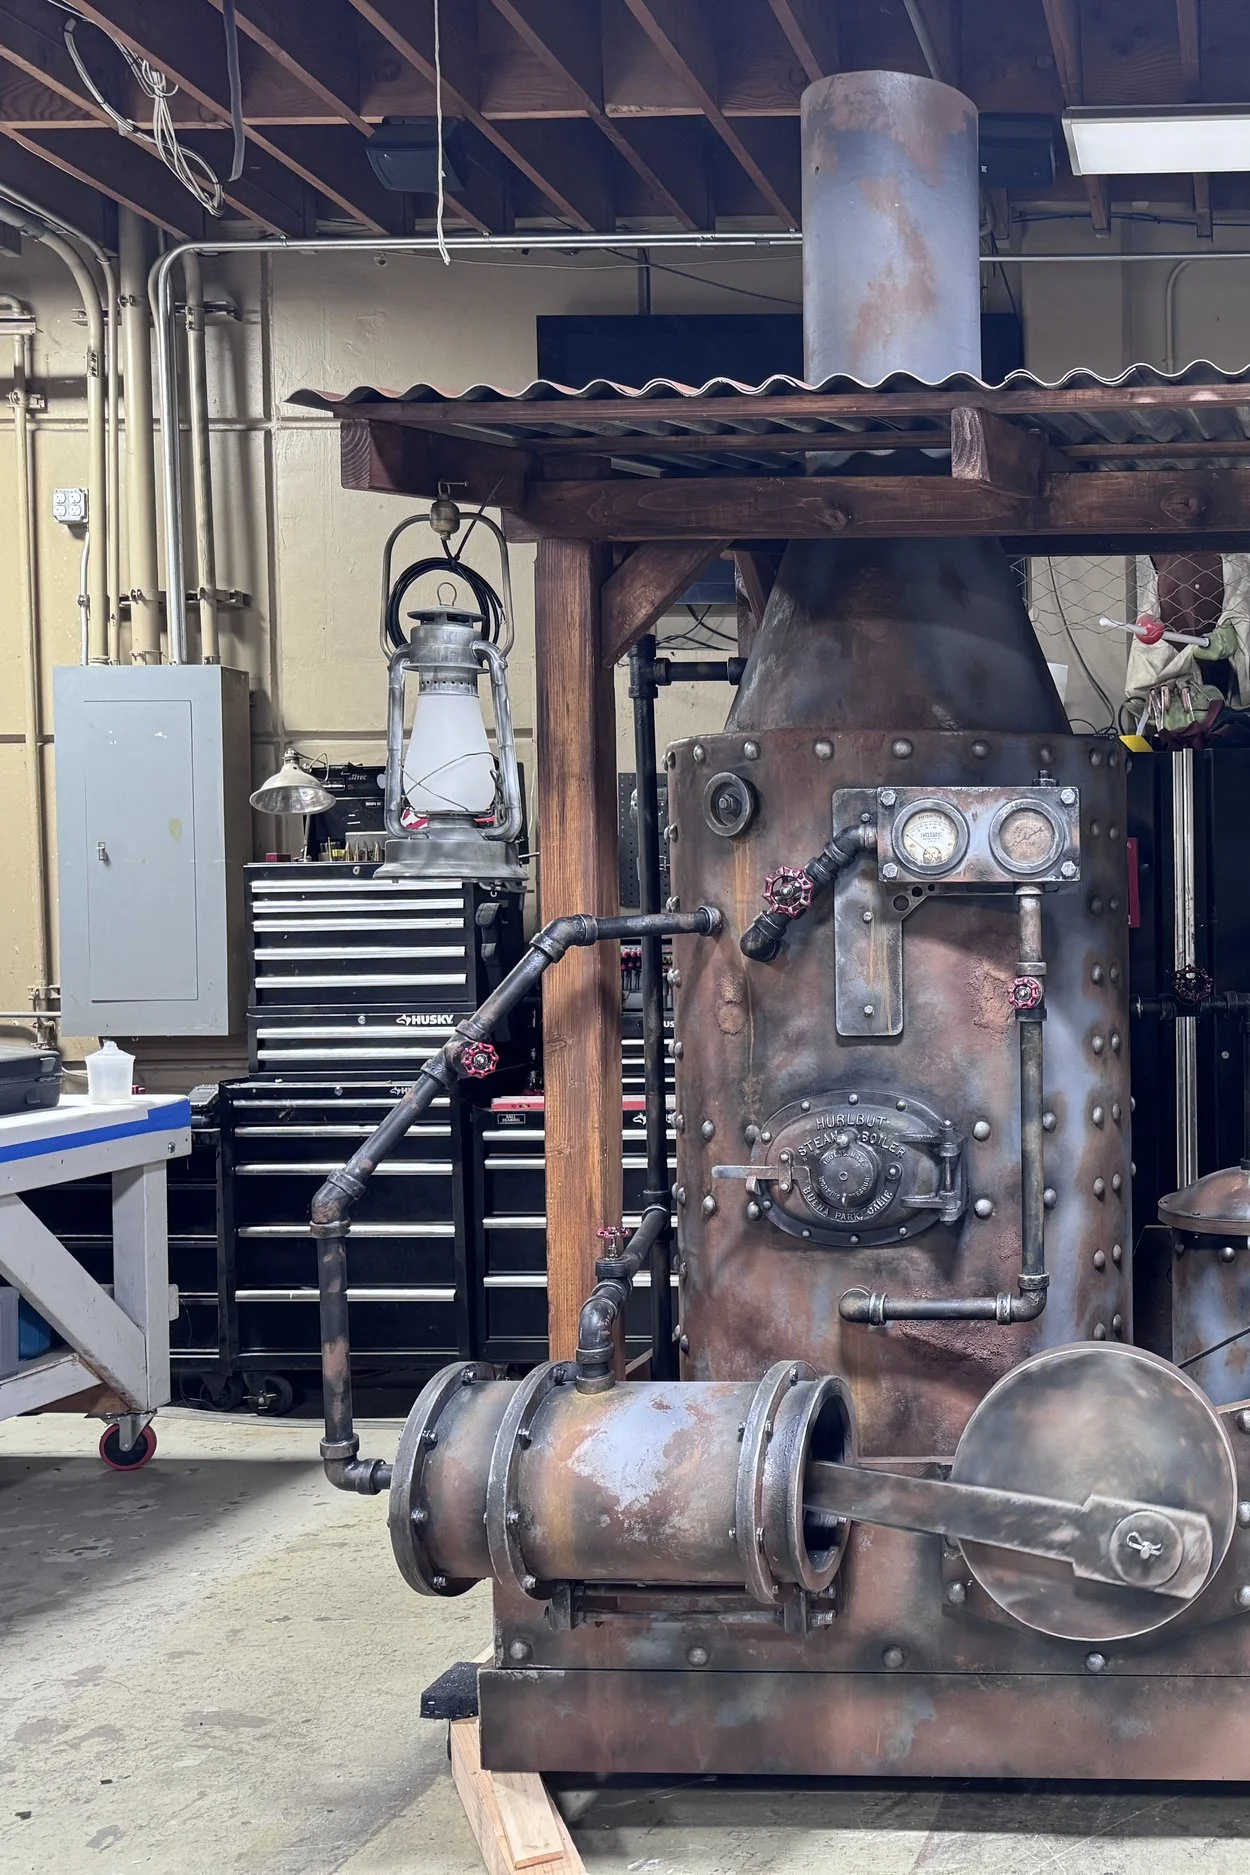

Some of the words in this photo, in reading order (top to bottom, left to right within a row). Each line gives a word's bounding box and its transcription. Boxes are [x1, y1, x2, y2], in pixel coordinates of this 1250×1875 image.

[411, 1014, 455, 1025] HUSKY
[815, 1112, 888, 1131] HURLBUT
[861, 1130, 907, 1159] BOILER
[803, 1186, 831, 1217] BUENA
